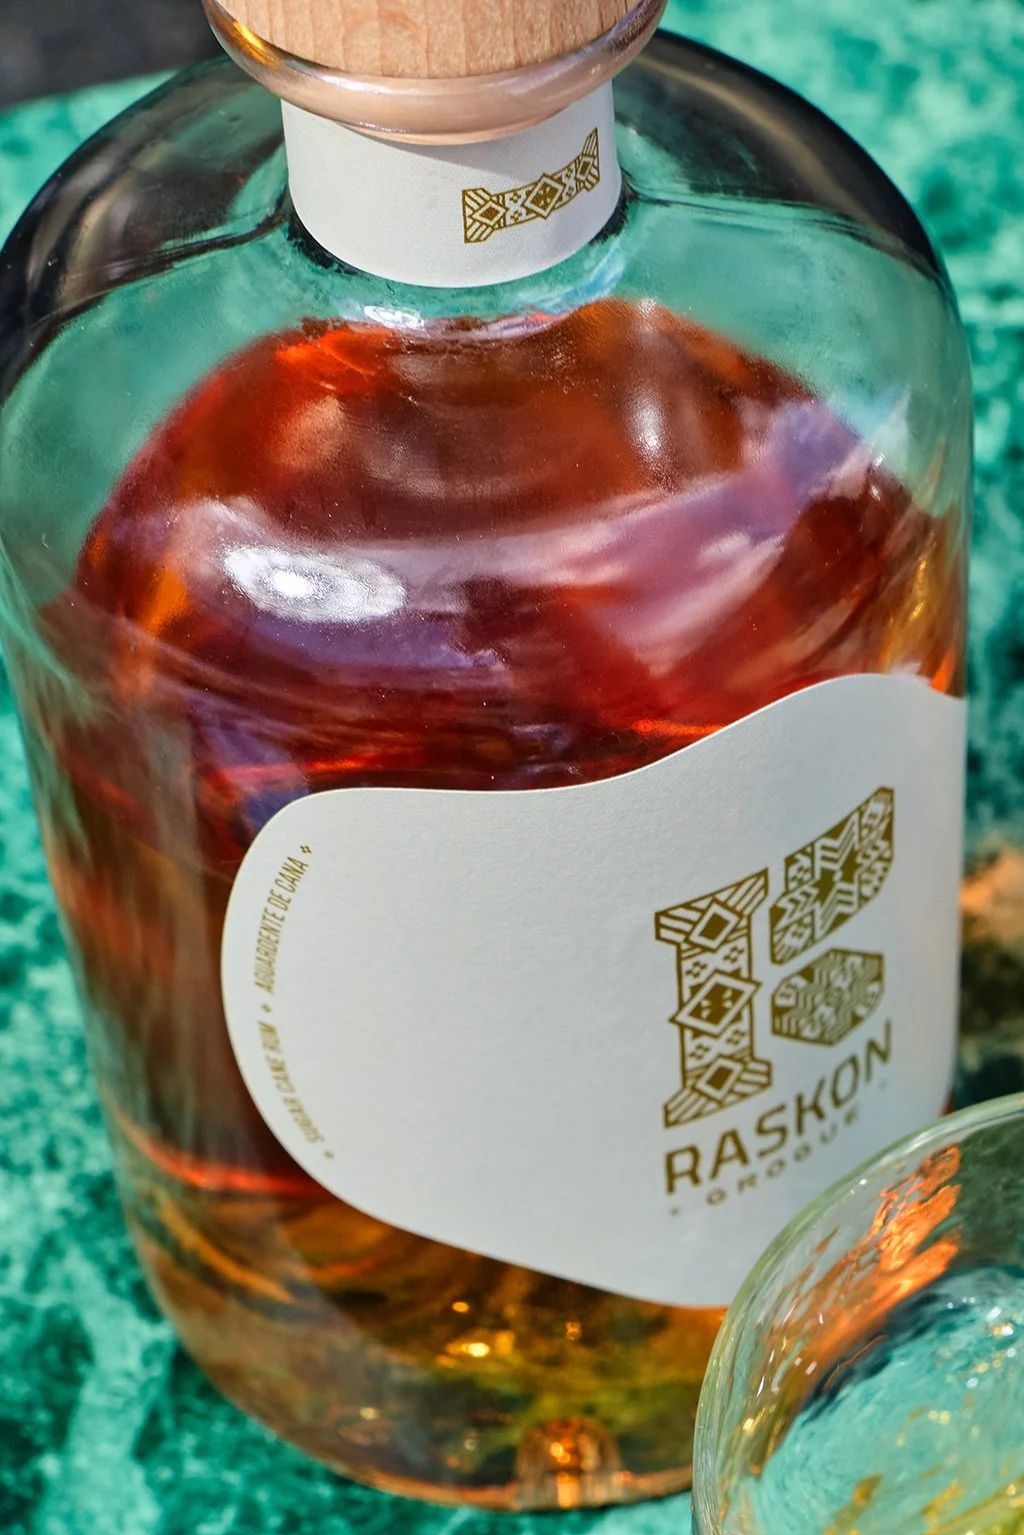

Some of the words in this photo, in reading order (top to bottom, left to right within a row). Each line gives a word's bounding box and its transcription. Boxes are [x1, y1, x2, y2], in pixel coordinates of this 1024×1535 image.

[271, 889, 293, 915] DE
[281, 855, 310, 895] CANA
[254, 905, 286, 993] AGUARDENTE
[256, 1020, 284, 1055] RUM
[664, 1017, 892, 1196] RASKON
[705, 1103, 860, 1206] GROGUE
